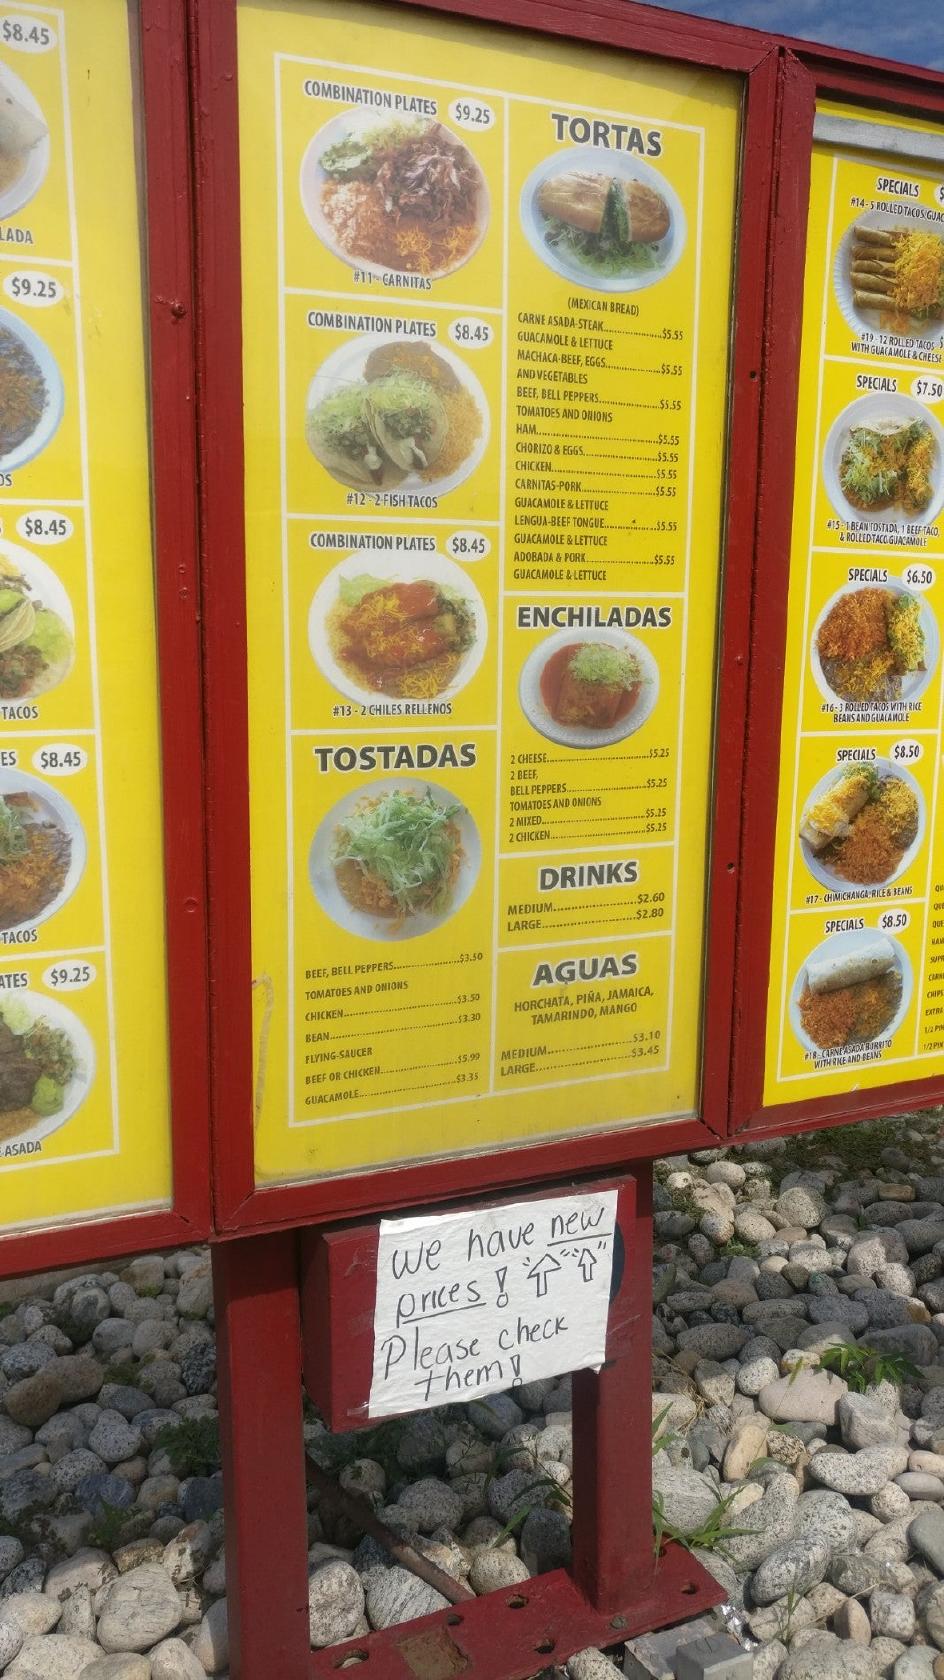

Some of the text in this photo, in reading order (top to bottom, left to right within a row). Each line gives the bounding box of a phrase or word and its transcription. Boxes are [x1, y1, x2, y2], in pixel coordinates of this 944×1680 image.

[2, 20, 50, 46] $8.45
[305, 80, 490, 124] COMBINATION PLATES $9.25
[552, 113, 661, 156] TORTAS
[877, 178, 919, 197] SPECIALS
[11, 276, 56, 298] $9.25
[354, 271, 432, 290] #11 CARNITAS
[568, 297, 639, 316] (MEXICAN BREAD)
[308, 312, 489, 341] COMBINATION PLATES $8.45
[518, 312, 683, 341] CARNE ASADA-STEAK $5.55
[852, 342, 941, 363] WITH GUACAMOLE & CHEESE
[880, 335, 887, 344] 12
[889, 336, 914, 347] ROLLED
[916, 340, 934, 350] TACOS
[517, 368, 588, 384] AND VEGETABLES
[585, 356, 606, 368] EGGS
[661, 363, 683, 376] $5.55
[857, 375, 942, 397] SPECIALS $7.50
[517, 387, 682, 410] BEEF, BELL PEPPERS $5.55
[516, 405, 612, 422] TOMATOES AND ONIONS
[516, 424, 680, 445] HAM $5.55
[516, 442, 679, 463] CHORIZO & EGGS $5.55
[515, 461, 677, 479] CHICKEN $5.55
[515, 479, 676, 497] CARNITAS-PORK $5.55
[347, 493, 437, 508] #12 2 FISH TACOS
[24, 517, 67, 536] $8.45
[515, 516, 677, 531] LENGUA-BEEF TONGUE $5.55
[310, 533, 485, 553] COMBINATION PLATES $8.45
[514, 552, 675, 565] ADOBADA & PORK $5.55
[848, 568, 932, 584] SPECIALS $6.50
[518, 606, 671, 627] ENCHILADAS
[2, 706, 39, 720] TACOS
[333, 703, 452, 717] #13 2 CHILES RELLENOS
[40, 751, 81, 768] $8.45
[314, 744, 476, 771] TOSTADAS
[510, 748, 669, 765] 2 CHEESE $5.25
[837, 745, 920, 761] SPECIALS $8.50
[510, 769, 538, 780] 2 BEEF,
[510, 778, 667, 796] BELL PEPPERS $5.25
[510, 797, 602, 811] TOMATOES AND ONIONS
[510, 808, 666, 827] 2 MIXED $5.25
[509, 823, 667, 843] 2 CHICKEN $5.25
[540, 861, 637, 890] DRINKS
[507, 892, 665, 915] MEDIUM $2.60
[806, 895, 818, 904] #17
[872, 889, 886, 898] RICE
[894, 886, 912, 896] BEANS
[507, 908, 664, 932] LARGE $2.80
[825, 914, 907, 933] SPECIALS $8.50
[2, 929, 38, 944] TACOS
[305, 952, 483, 979] BEEF, BELL PEPPERS $3.50
[532, 953, 637, 986] AGUAS
[50, 966, 90, 986] $9.25
[305, 981, 408, 1000] TOMATOES AND ONIONS
[514, 986, 654, 1012] HORCHATA, PIÑA, JAMAICA,
[305, 993, 480, 1021] CHICKEN $3.50
[531, 1002, 637, 1025] TAMARINDO, MANGO
[305, 1013, 481, 1043] BEAN $3.30
[305, 1047, 372, 1064] FLYING-SAUCER
[501, 1030, 661, 1061] MEDIUM $3.10
[305, 1053, 481, 1084] BEEF OR CHICKEN $5.99
[501, 1045, 660, 1077] LARGE $3.45
[815, 1050, 882, 1069] WITH RICE AND BEANS
[305, 1072, 478, 1105] GUACAMOLE $3.35
[5, 1141, 42, 1157] ASADA
[467, 1222, 535, 1262] have
[551, 1207, 605, 1238] new
[499, 1314, 568, 1351] check
